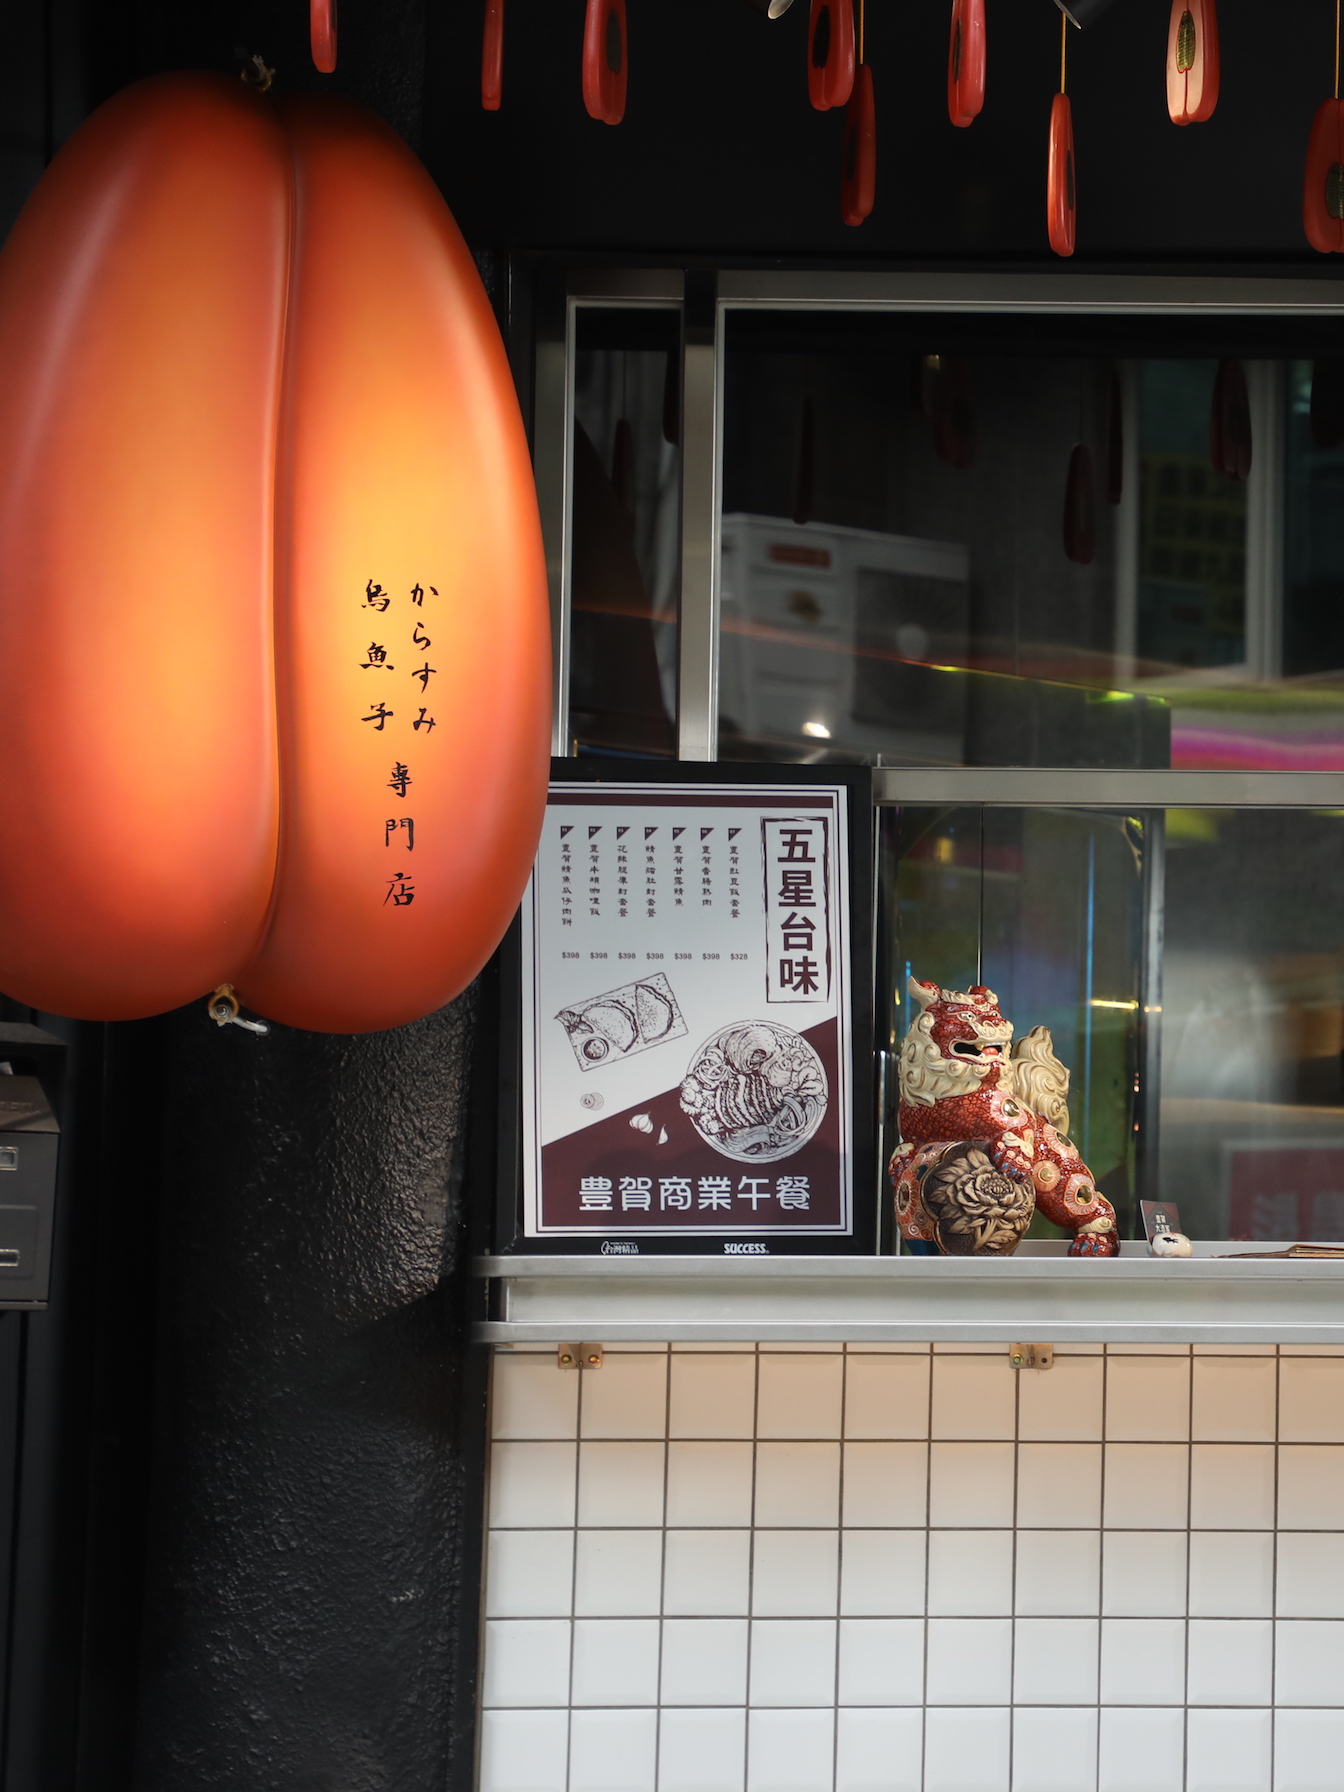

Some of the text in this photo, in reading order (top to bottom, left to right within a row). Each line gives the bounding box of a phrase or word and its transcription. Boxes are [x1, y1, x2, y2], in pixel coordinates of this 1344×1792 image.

[359, 579, 394, 731] 烏魚子
[411, 583, 439, 734] からすみ
[383, 761, 415, 907] 專門店
[562, 951, 749, 961] $398 $398 $398 $398 $398 $398 $328
[777, 828, 819, 995] 五星台味
[723, 1243, 767, 1255] SUCCESS
